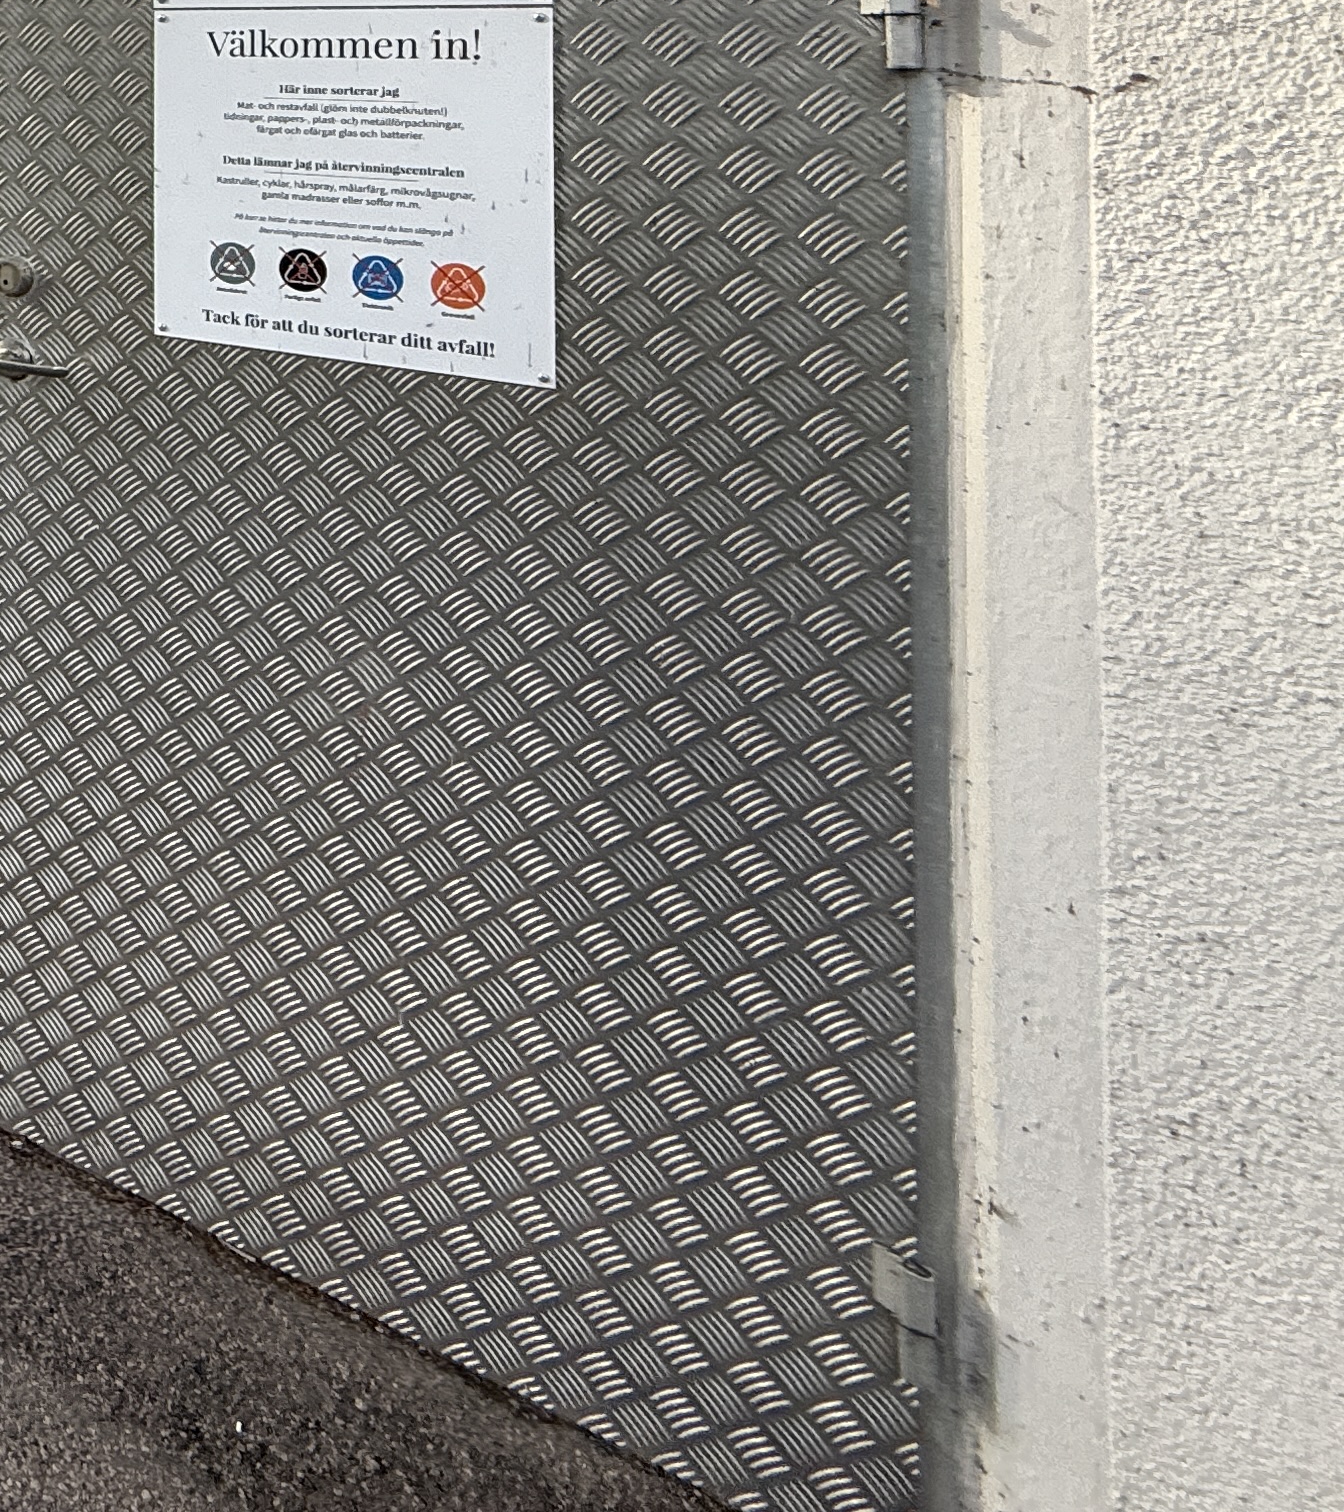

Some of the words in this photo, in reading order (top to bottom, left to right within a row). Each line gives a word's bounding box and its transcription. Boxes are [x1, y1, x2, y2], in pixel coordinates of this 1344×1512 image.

[207, 29, 419, 60] Välkommen
[431, 29, 481, 61] in!
[279, 84, 301, 94] Här
[303, 85, 328, 95] inne
[330, 86, 379, 96] sorterar
[379, 86, 400, 98] jag
[258, 102, 275, 110] och
[277, 103, 318, 111] restavfall
[284, 126, 302, 135] och
[338, 128, 358, 139] glas
[360, 129, 378, 138] och
[223, 155, 251, 166] Detta
[253, 156, 293, 168] lämnar
[293, 158, 313, 171] jag
[315, 159, 329, 171] på
[331, 160, 465, 178] återvinningscentralen
[342, 196, 363, 205] eller
[365, 198, 393, 207] soffor
[202, 308, 241, 326] Tack
[244, 313, 269, 329] för
[272, 319, 294, 333] att
[297, 320, 319, 336] du
[324, 327, 397, 345] sorterar
[401, 333, 433, 350] ditt
[437, 339, 495, 358] avfall!
